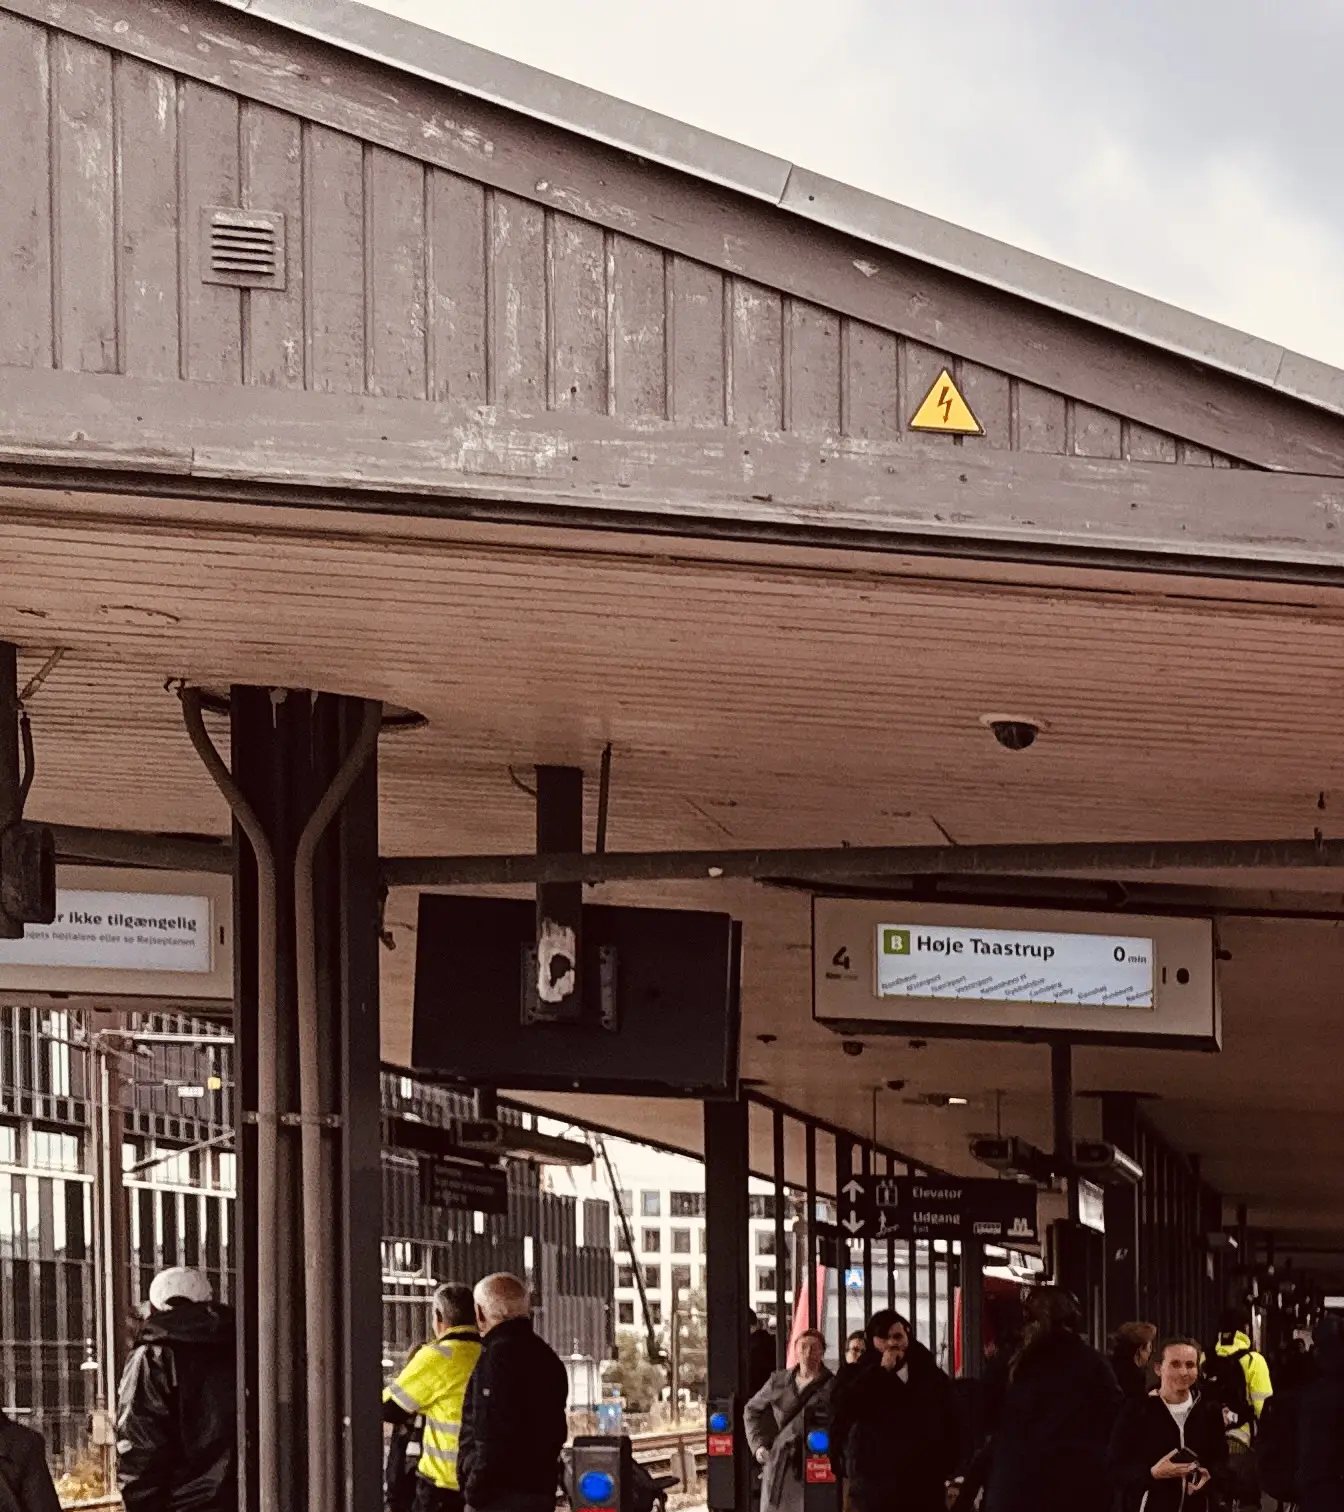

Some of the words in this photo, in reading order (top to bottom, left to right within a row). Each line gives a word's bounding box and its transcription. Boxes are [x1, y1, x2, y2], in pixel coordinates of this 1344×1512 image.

[69, 911, 102, 925] ikke
[107, 913, 197, 932] tilgængelig
[832, 945, 850, 970] 4
[890, 935, 903, 951] B
[917, 935, 963, 957] Høje
[970, 938, 1055, 961] Taastrup
[1113, 946, 1125, 963] 0
[1128, 954, 1147, 964] min
[912, 1187, 963, 1200] Elevator
[912, 1211, 961, 1226] Udgang
